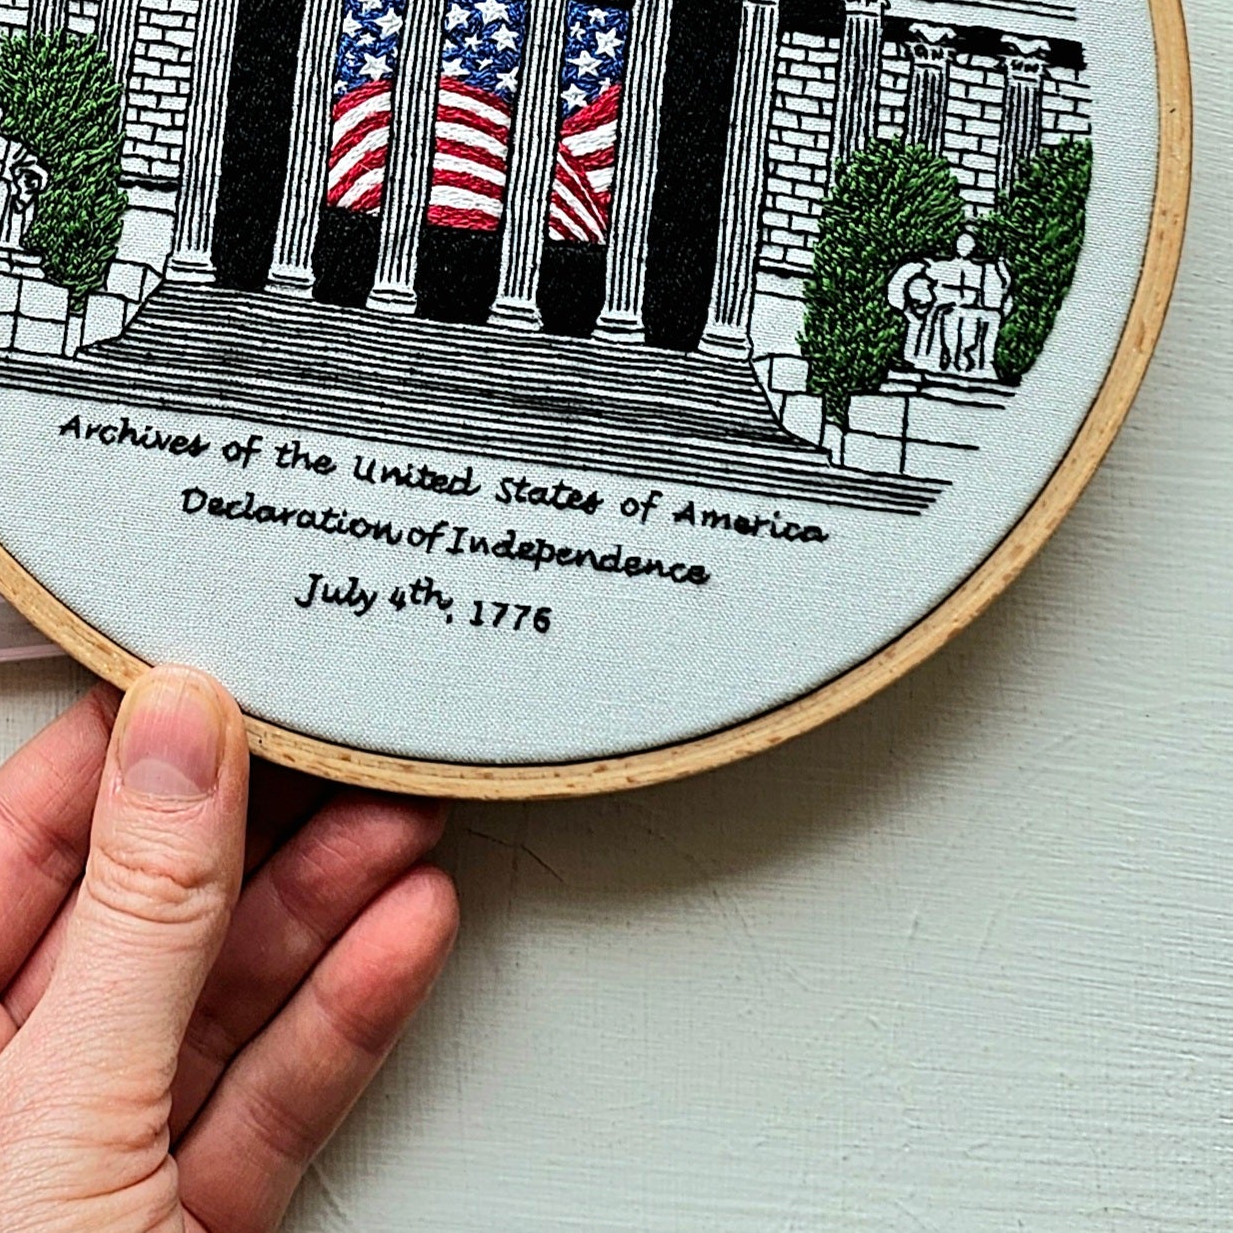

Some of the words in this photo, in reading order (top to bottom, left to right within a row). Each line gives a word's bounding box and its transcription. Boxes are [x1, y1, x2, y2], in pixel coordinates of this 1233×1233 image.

[59, 414, 210, 457] Archives
[222, 435, 264, 467] of
[274, 441, 337, 475] the
[353, 454, 481, 497] United
[495, 475, 604, 516] States
[620, 490, 664, 525] of
[672, 501, 829, 544] America
[181, 485, 404, 547] Declaration
[407, 519, 450, 554] of
[446, 525, 711, 586] Independence
[294, 573, 378, 617] July
[469, 600, 554, 635] 1776
